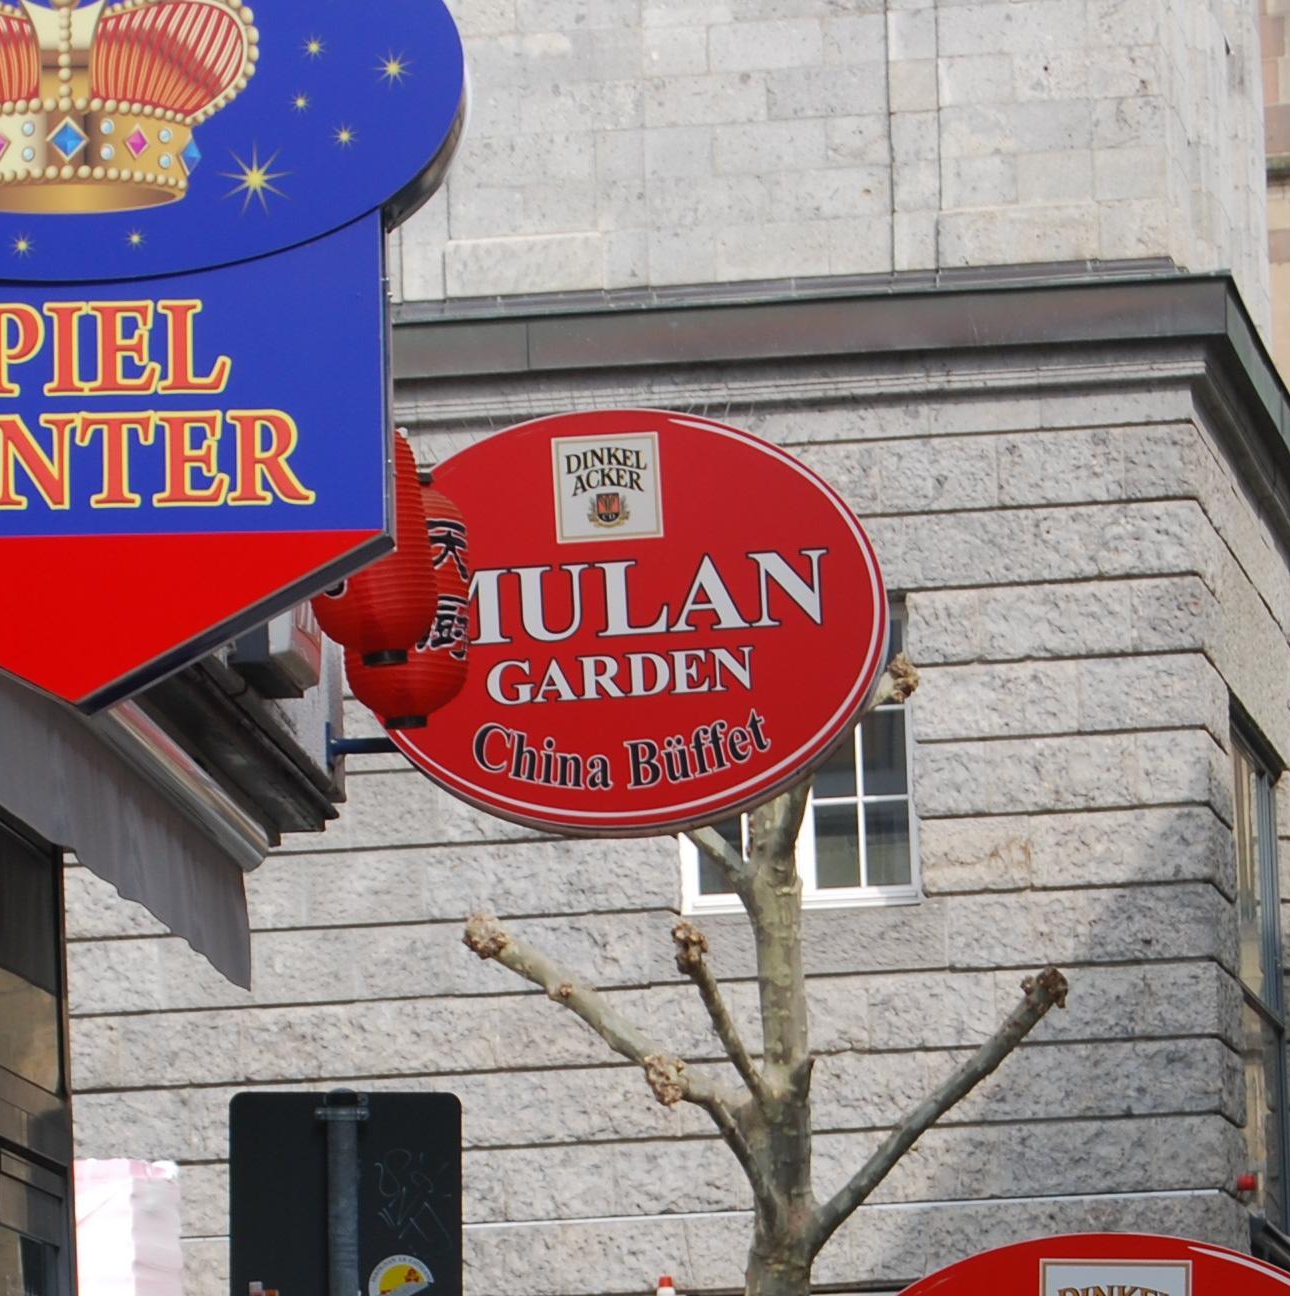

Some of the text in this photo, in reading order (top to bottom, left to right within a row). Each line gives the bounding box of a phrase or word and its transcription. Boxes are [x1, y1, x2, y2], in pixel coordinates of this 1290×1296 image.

[565, 446, 647, 475] DINKEL
[572, 467, 645, 497] ACKER
[486, 646, 754, 705] GARDEN
[473, 708, 771, 792] China Büffet
